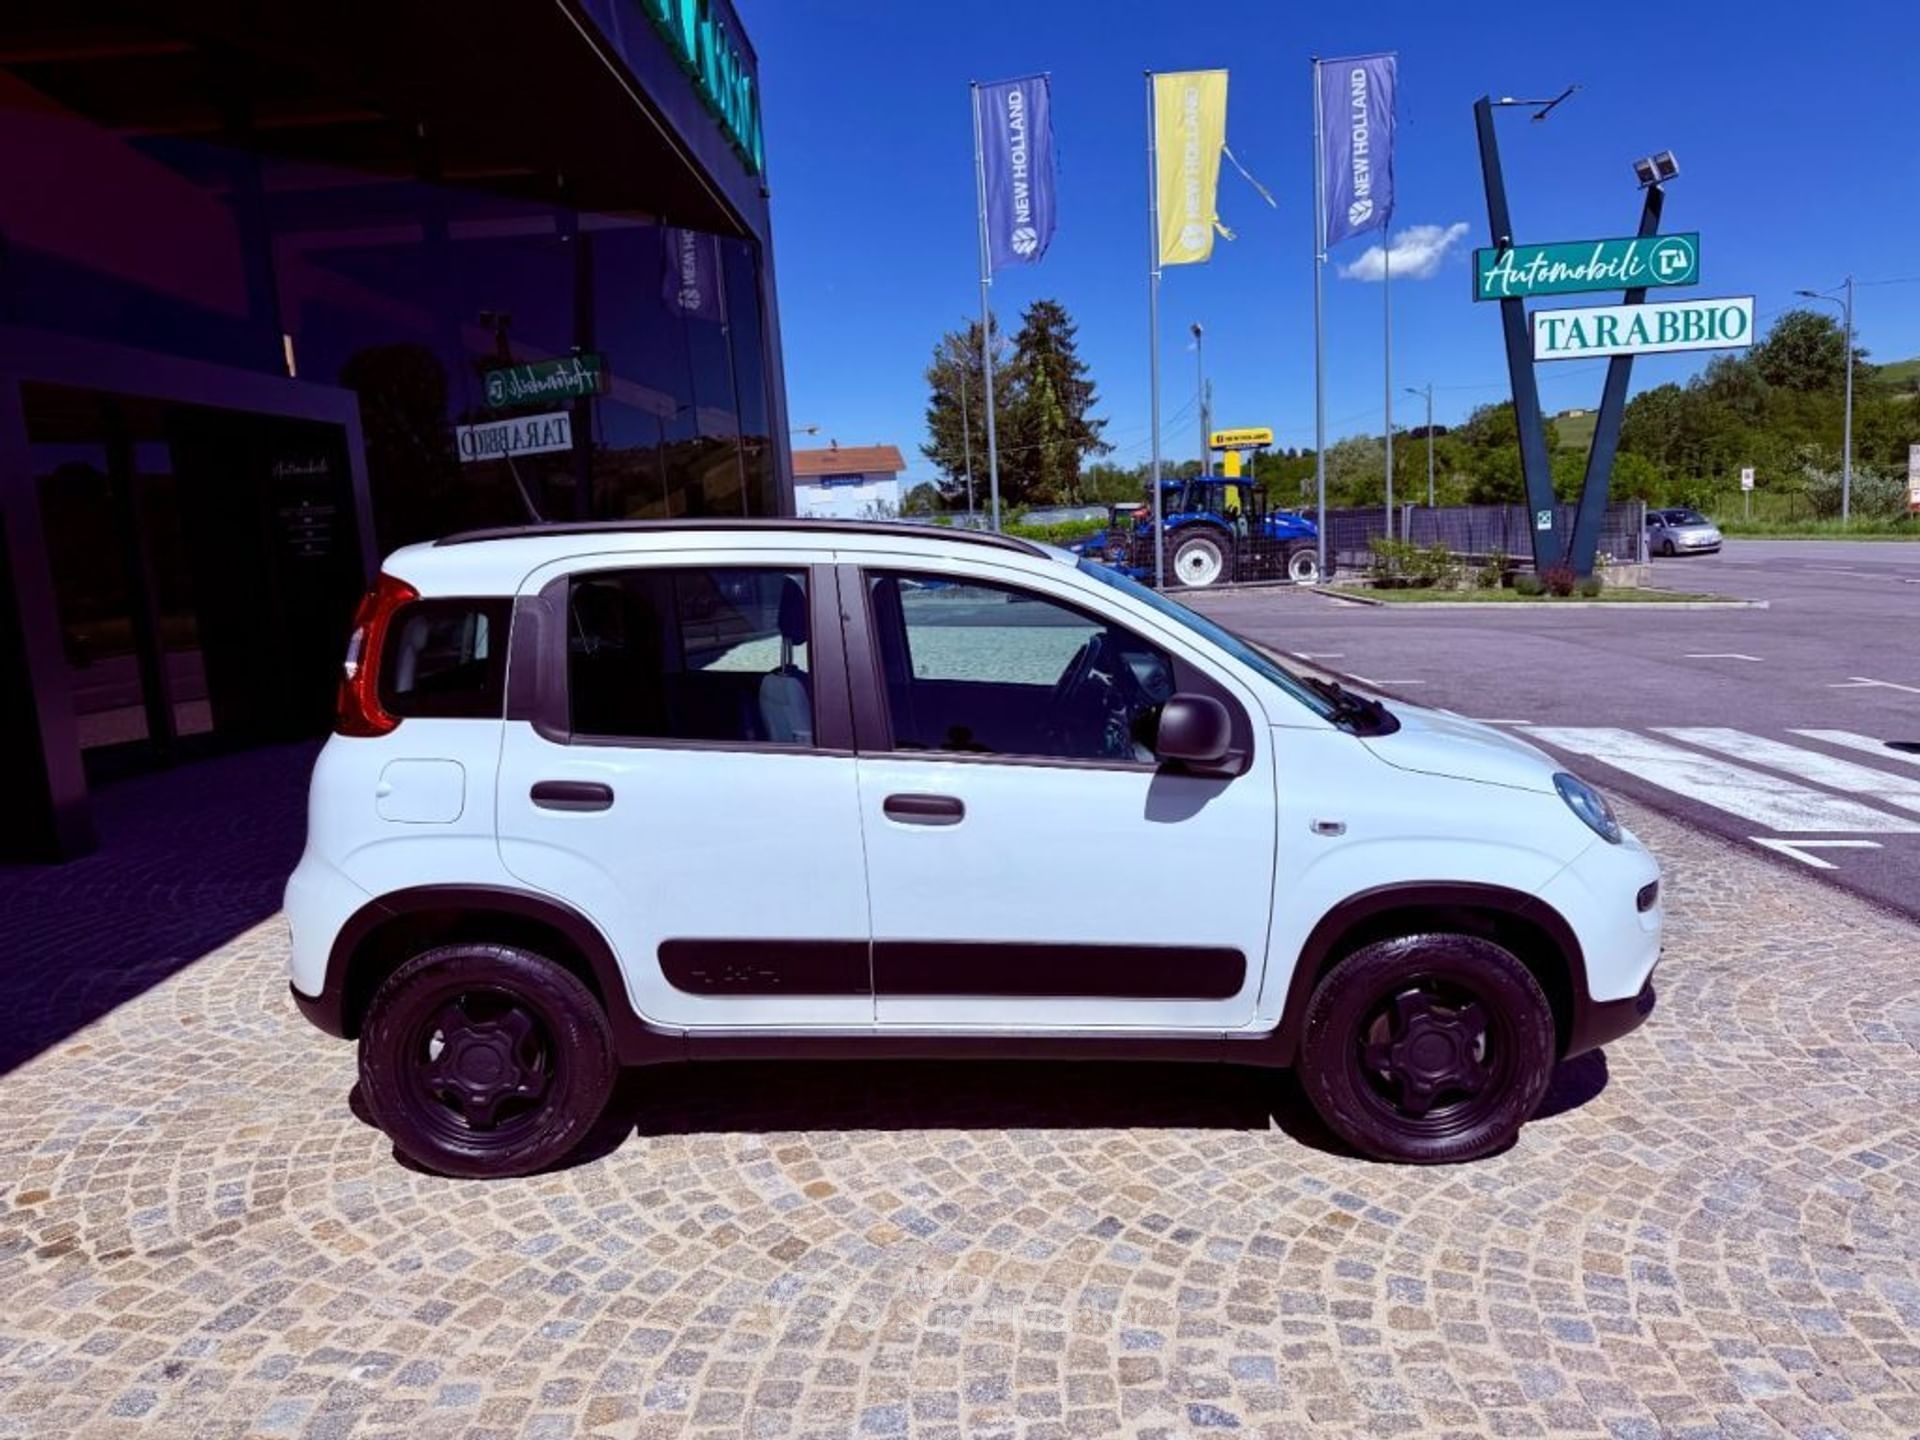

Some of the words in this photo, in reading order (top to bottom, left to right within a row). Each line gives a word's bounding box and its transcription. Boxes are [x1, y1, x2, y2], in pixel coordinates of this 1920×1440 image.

[1008, 91, 1027, 179] HOLLAND
[1351, 69, 1369, 158] HOLLAND
[1013, 181, 1031, 223] NEW
[1353, 158, 1371, 196] NEW
[1484, 241, 1646, 295] Automobili
[1539, 305, 1748, 351] TARABBIO
